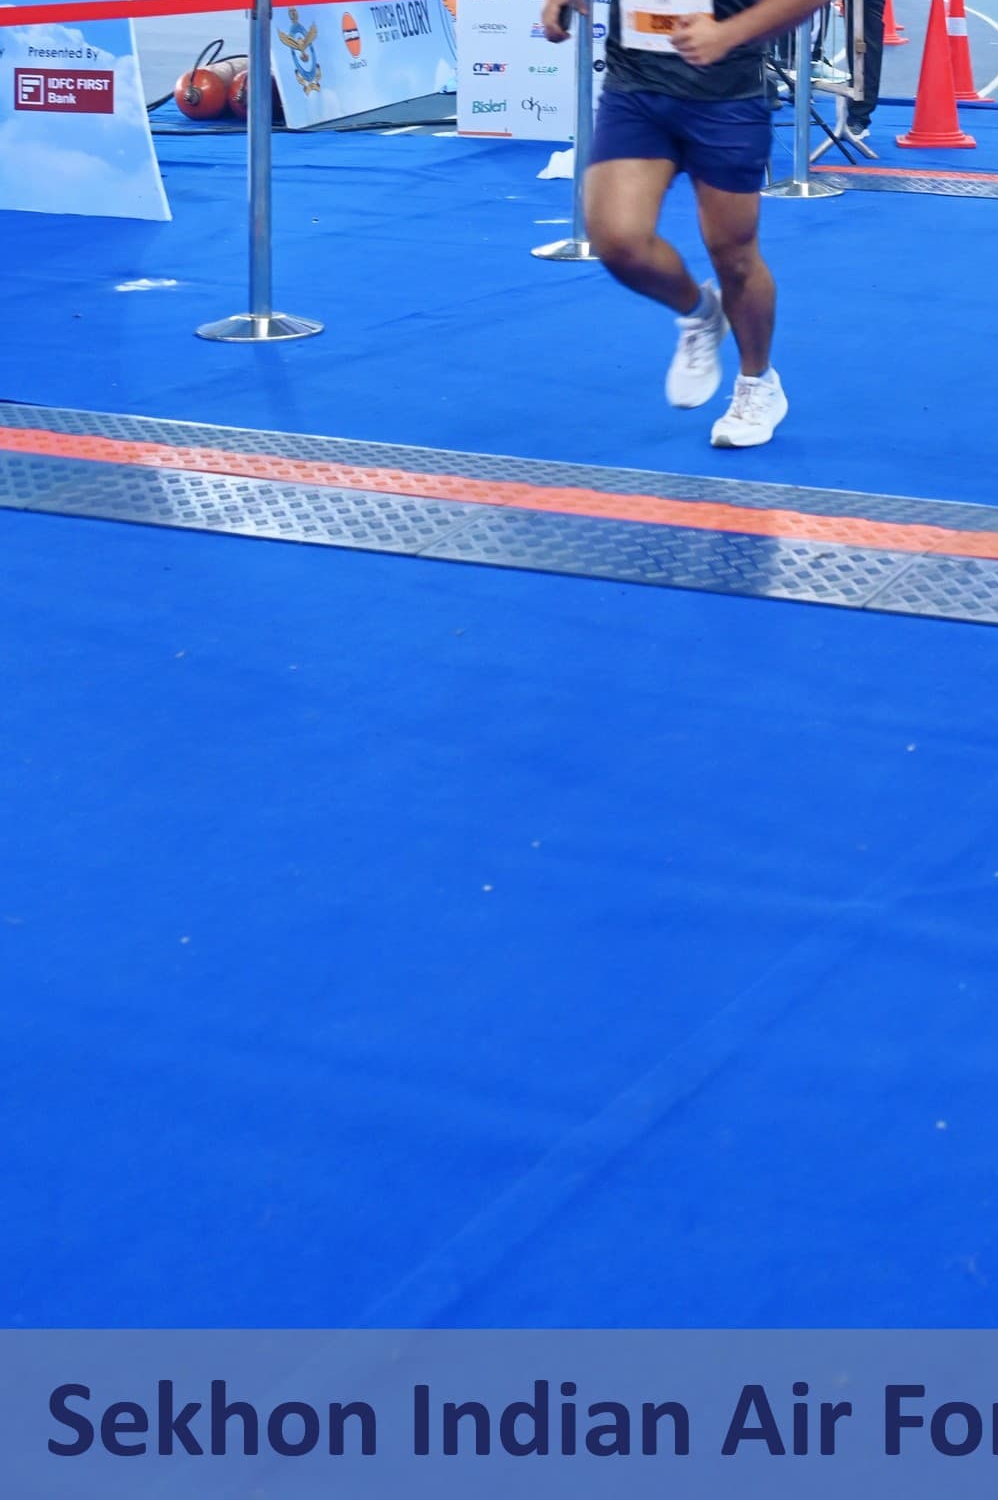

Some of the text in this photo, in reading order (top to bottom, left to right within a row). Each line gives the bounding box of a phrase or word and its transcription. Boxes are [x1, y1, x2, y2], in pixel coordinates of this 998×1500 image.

[396, 0, 432, 38] GLORY
[28, 46, 99, 61] Presented By
[48, 77, 110, 91] IDFC FIRST
[48, 92, 76, 104] Bank
